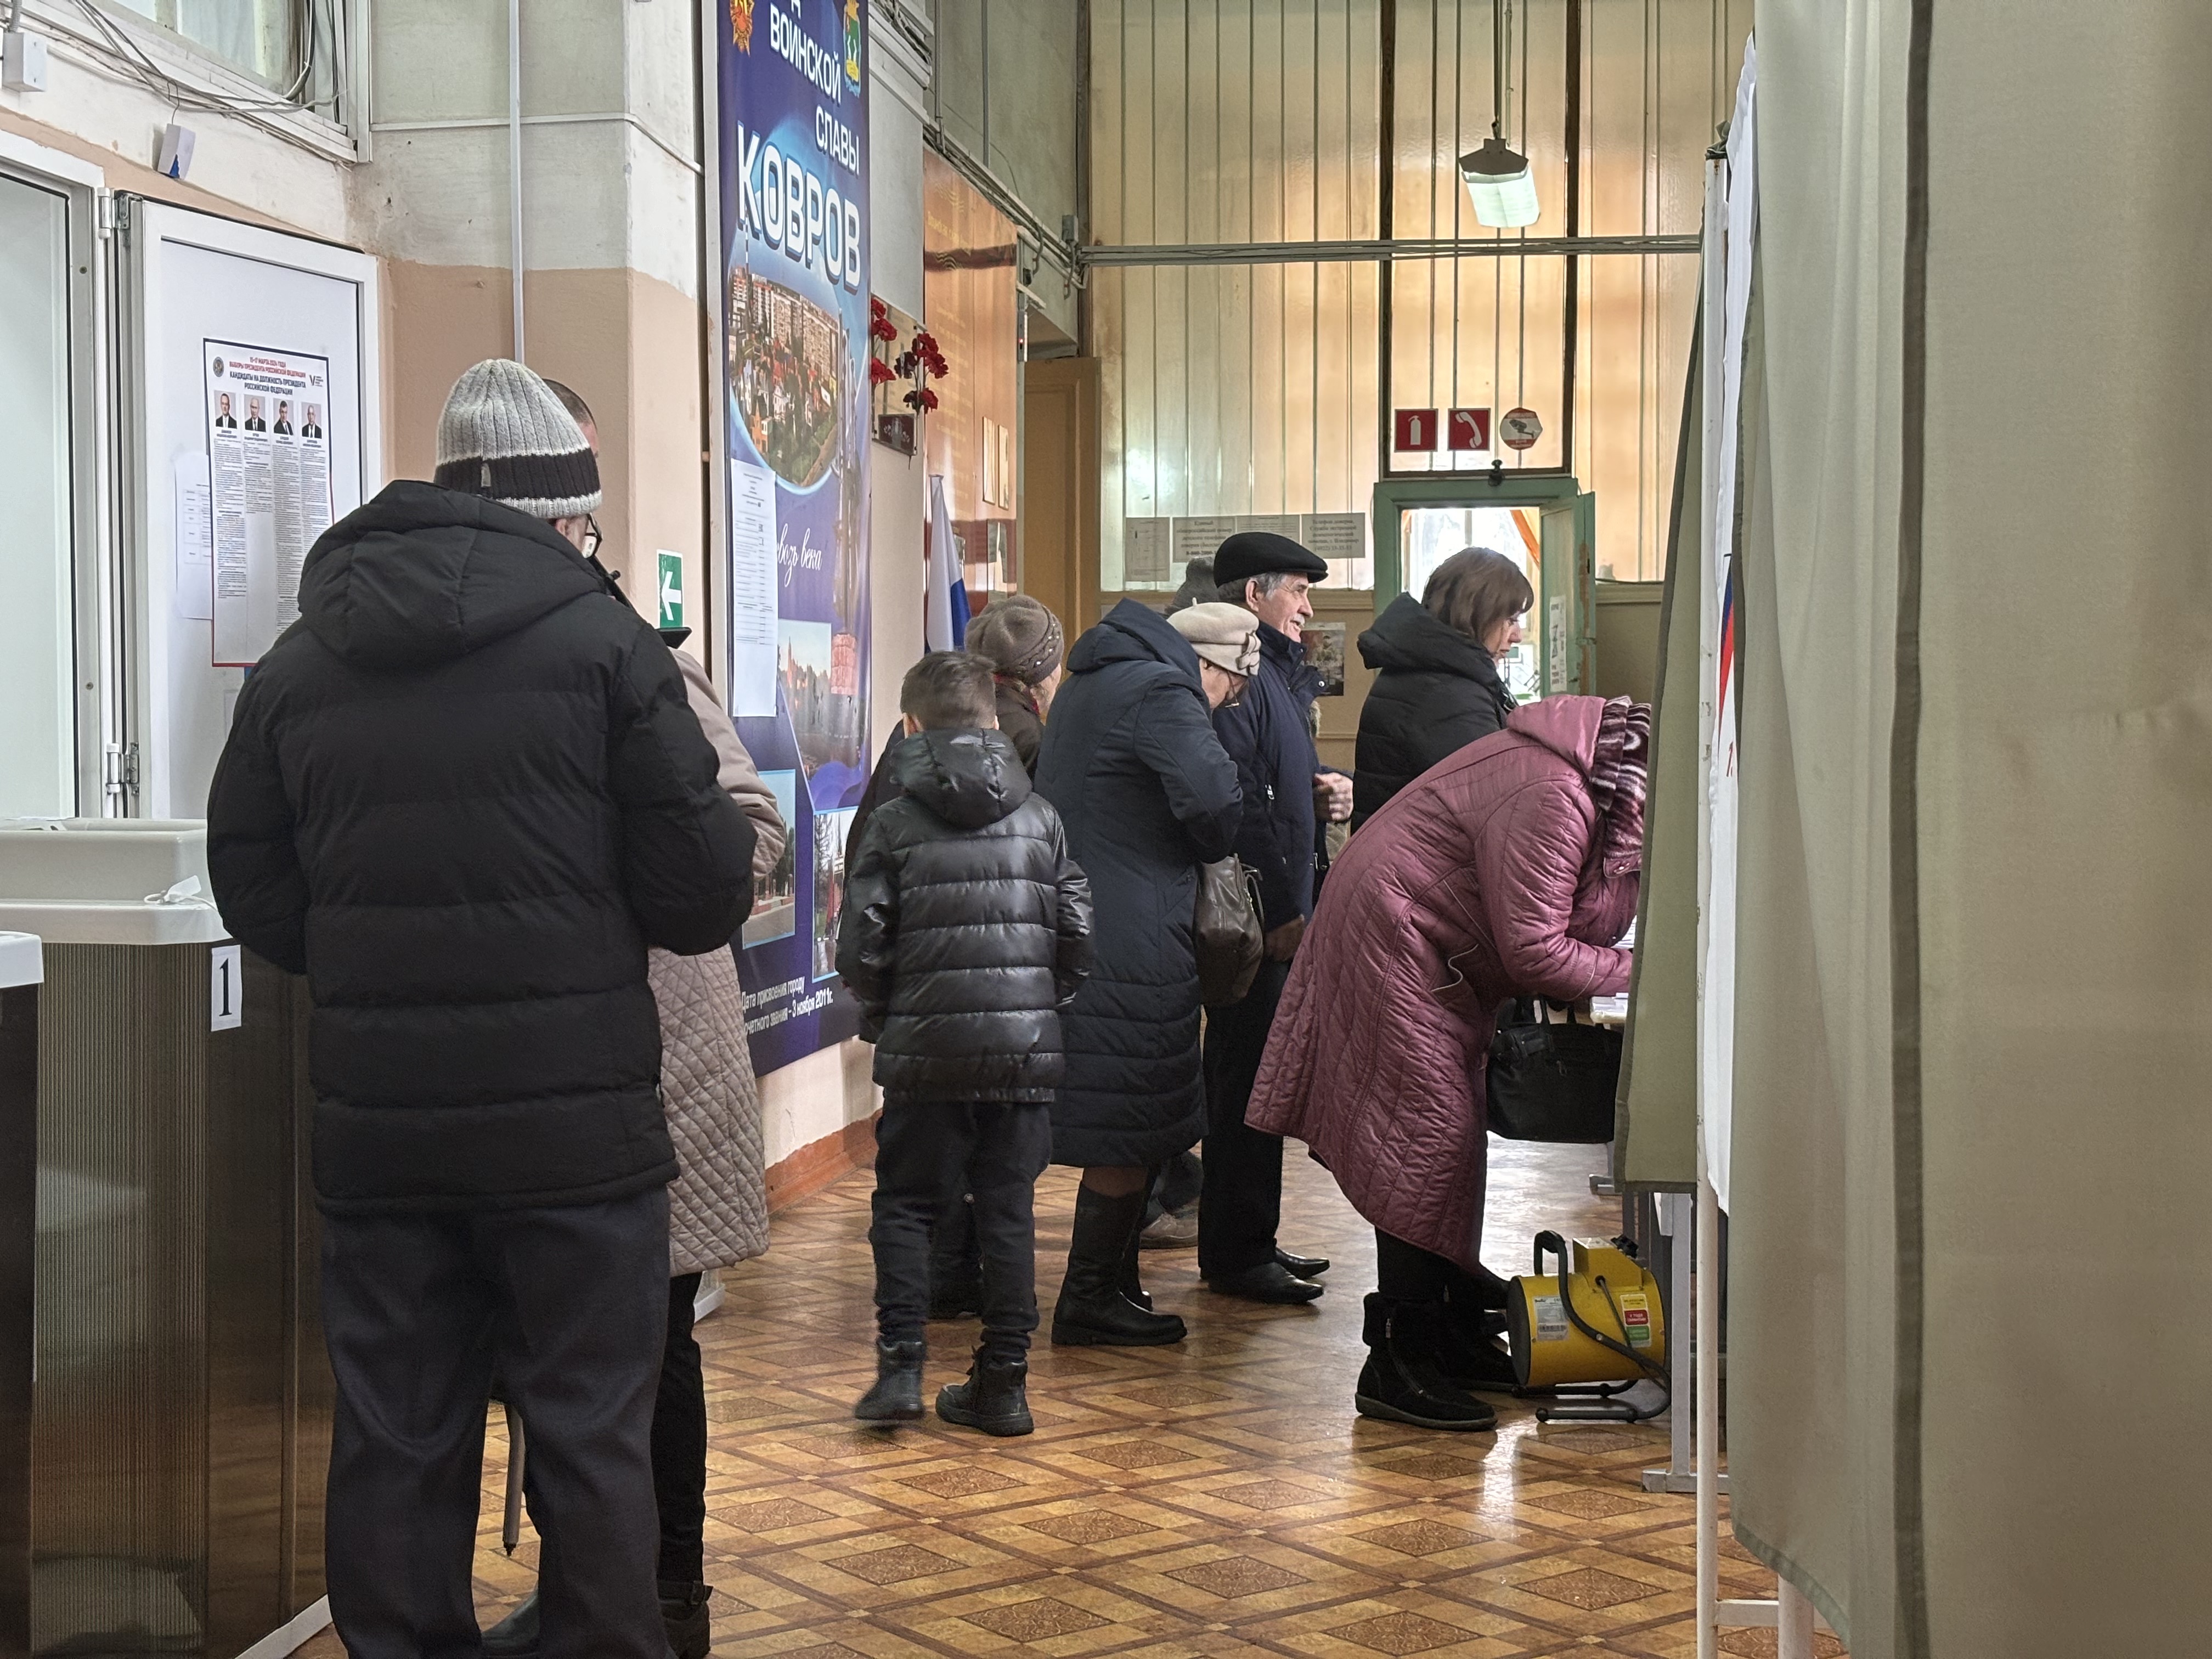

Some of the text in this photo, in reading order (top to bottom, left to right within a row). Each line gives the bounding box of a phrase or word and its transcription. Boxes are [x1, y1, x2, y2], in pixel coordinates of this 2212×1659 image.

[770, 2, 841, 104] ВОИНСКОЙ
[816, 105, 860, 175] СЛАВЫ
[737, 120, 861, 291] КОВРОВ
[777, 523, 799, 588] возь
[801, 527, 822, 571] века
[219, 958, 232, 1017] 1
[741, 976, 805, 1014] Дата присвоения городу
[744, 1014, 770, 1036] очетного
[770, 1007, 788, 1026] звания
[792, 1000, 796, 1018] 3
[797, 995, 815, 1016] ноября
[815, 987, 833, 1009] 2011г.
